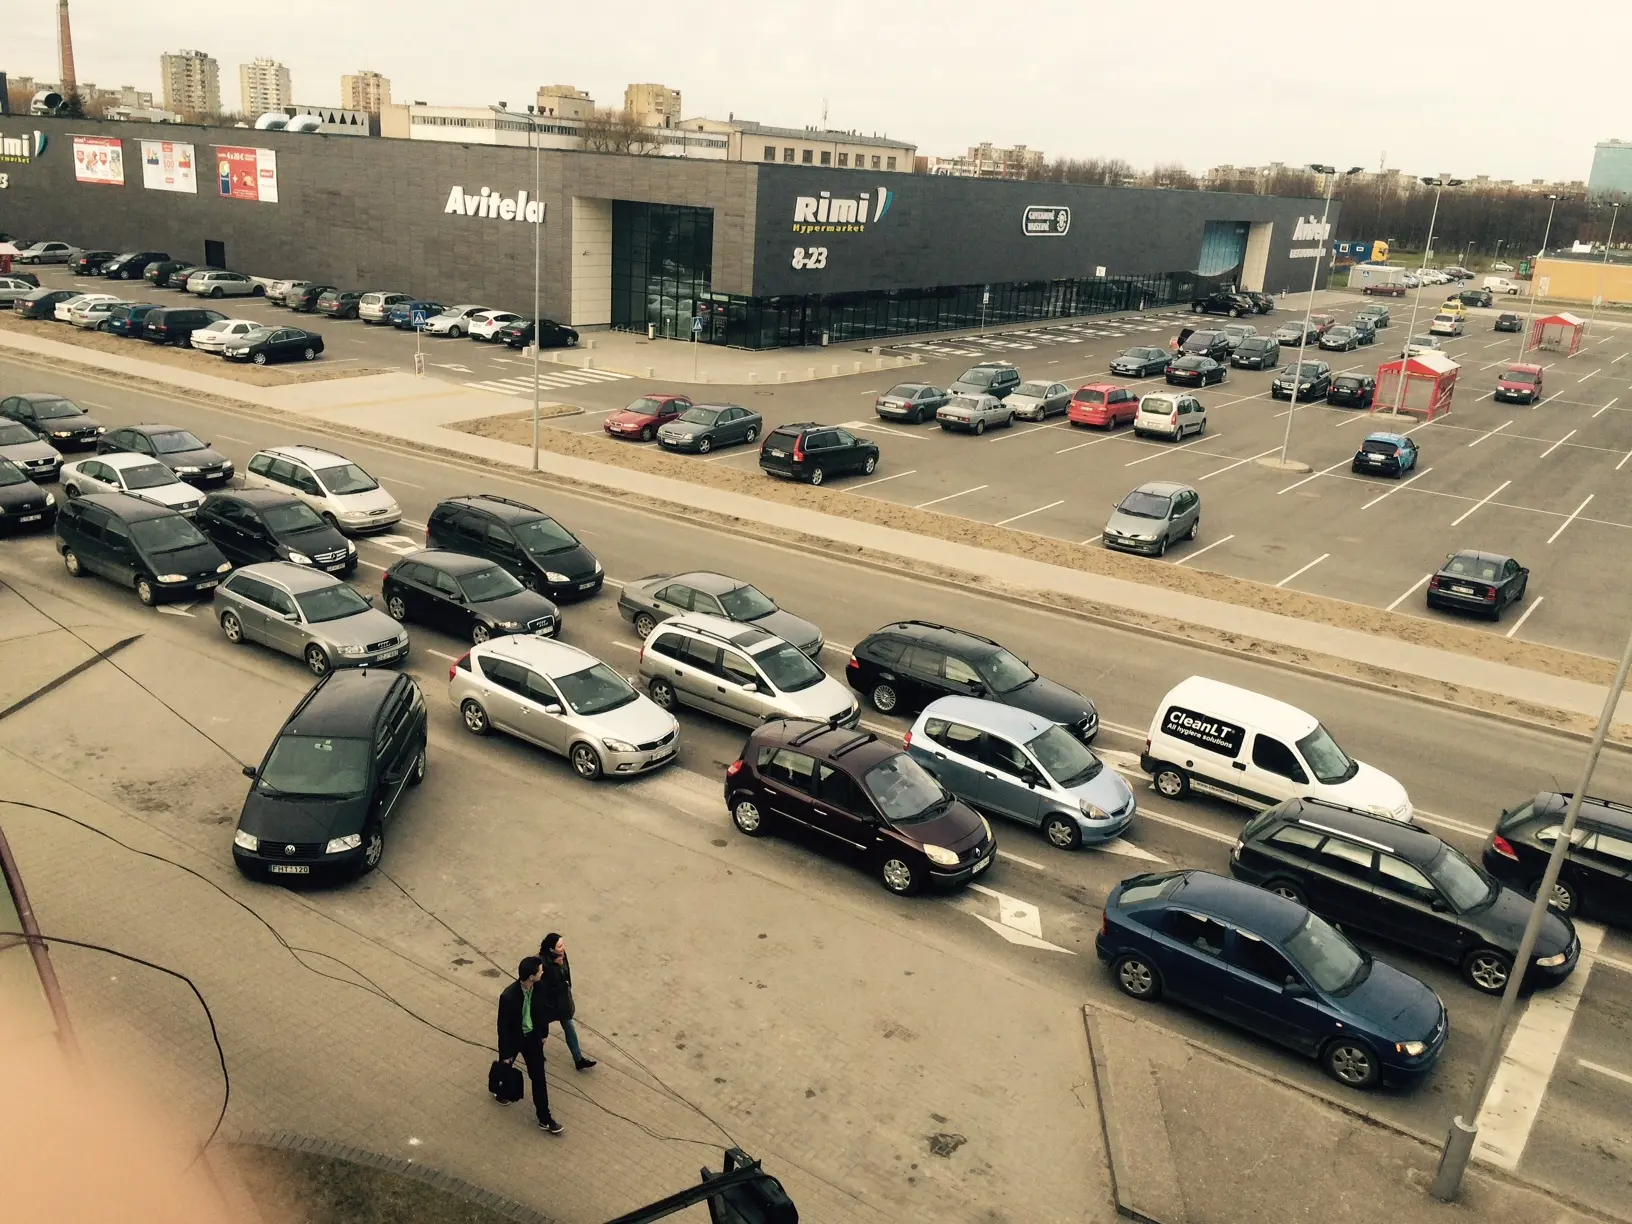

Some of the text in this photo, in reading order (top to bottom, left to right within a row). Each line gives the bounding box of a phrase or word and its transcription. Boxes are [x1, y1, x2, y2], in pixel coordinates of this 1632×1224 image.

[444, 185, 546, 223] Avitela
[793, 190, 870, 223] Rimi
[792, 224, 865, 234] Hypermarket
[791, 246, 828, 270] 8-23
[1166, 722, 1233, 749] All hygiene solutions
[1169, 711, 1232, 738] CleanLT
[294, 865, 308, 873] 120
